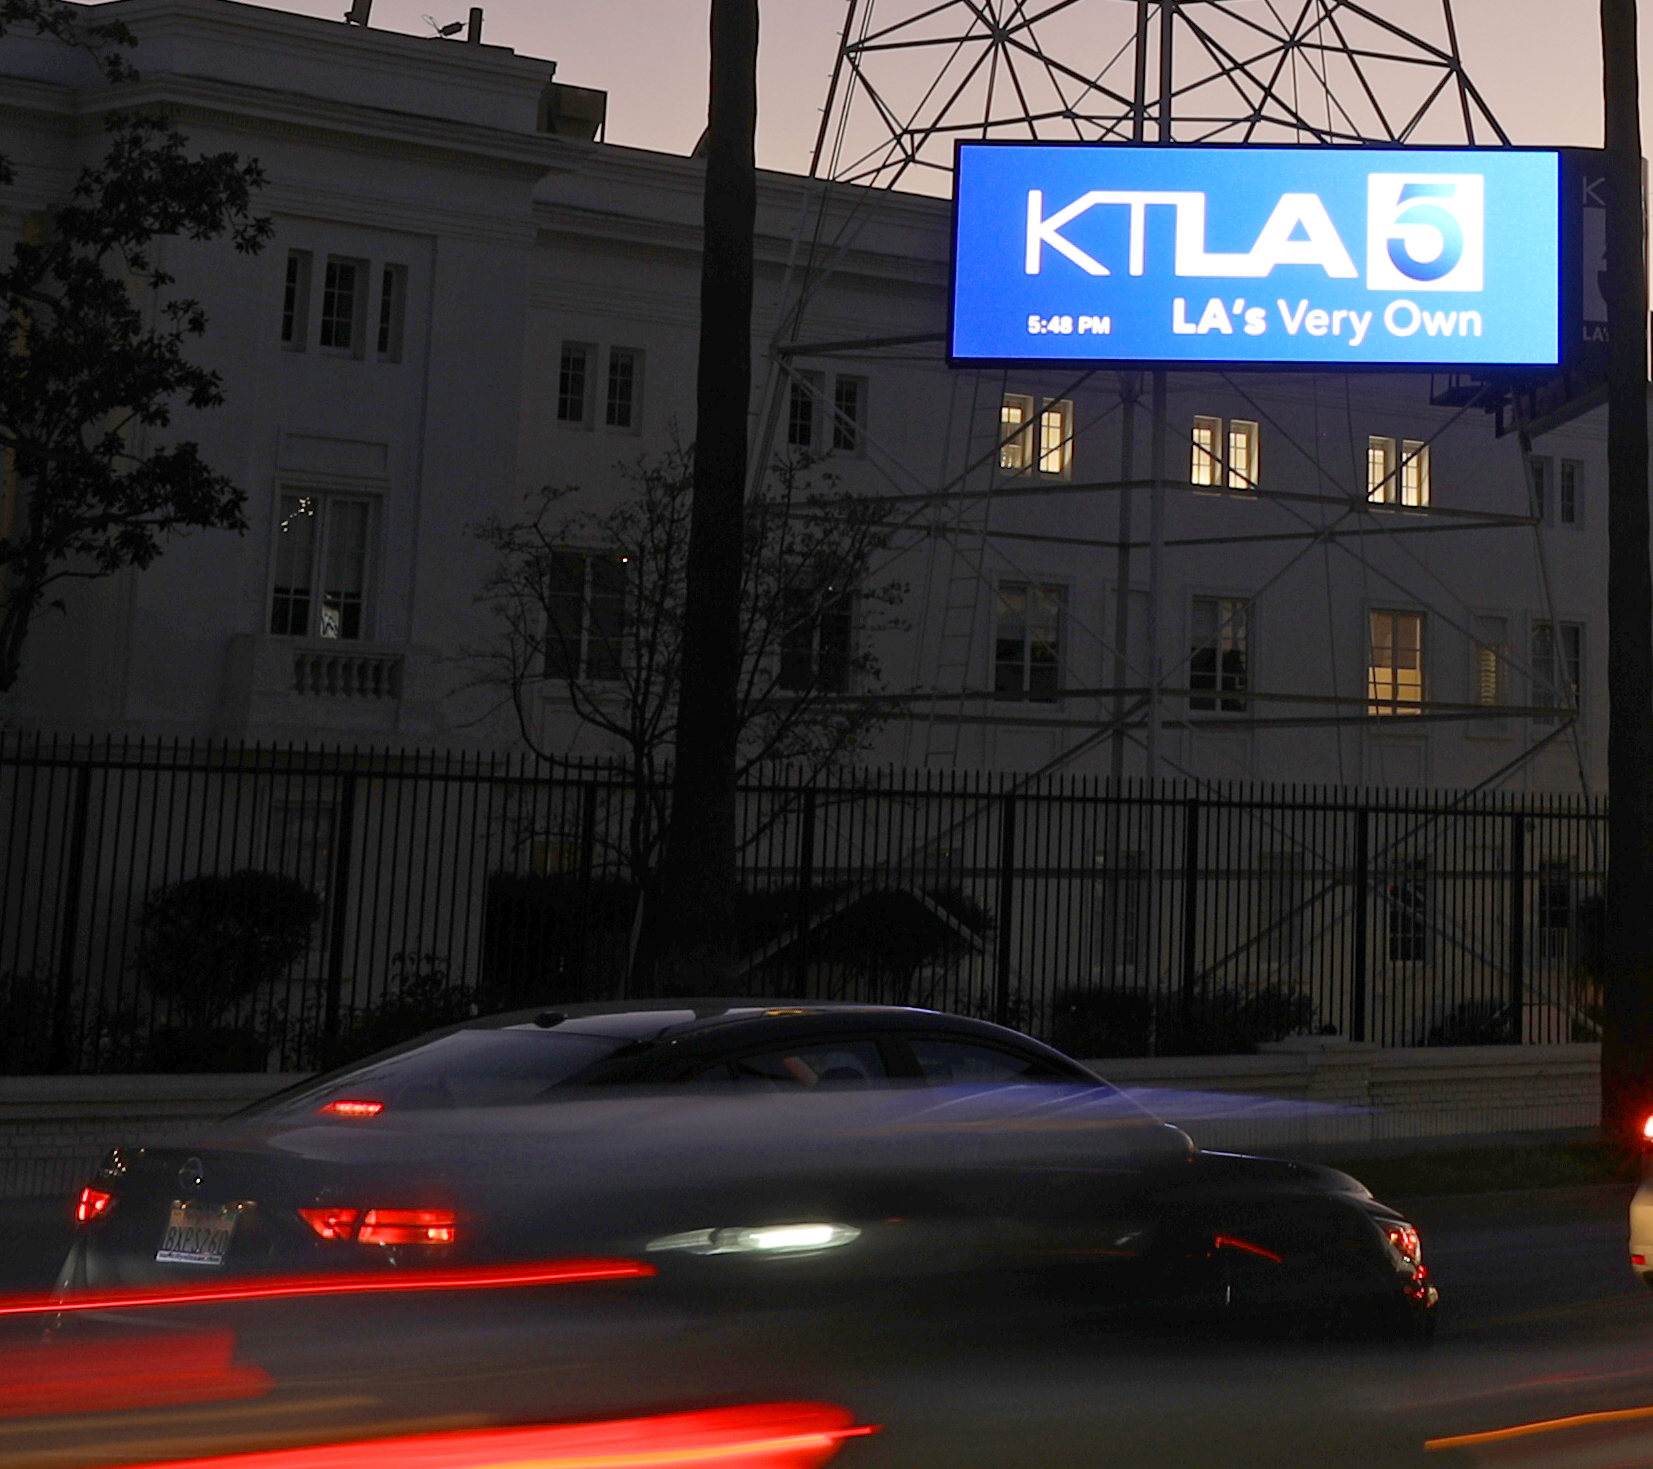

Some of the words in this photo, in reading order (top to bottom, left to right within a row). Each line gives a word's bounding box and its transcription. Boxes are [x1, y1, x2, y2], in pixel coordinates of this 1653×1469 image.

[1025, 189, 1359, 278] KTLA
[1386, 182, 1465, 282] 5
[1027, 315, 1074, 335] 5:48
[1077, 316, 1111, 335] PM
[1172, 297, 1267, 336] LA's
[1277, 299, 1373, 347] Very
[1384, 299, 1483, 337] Own
